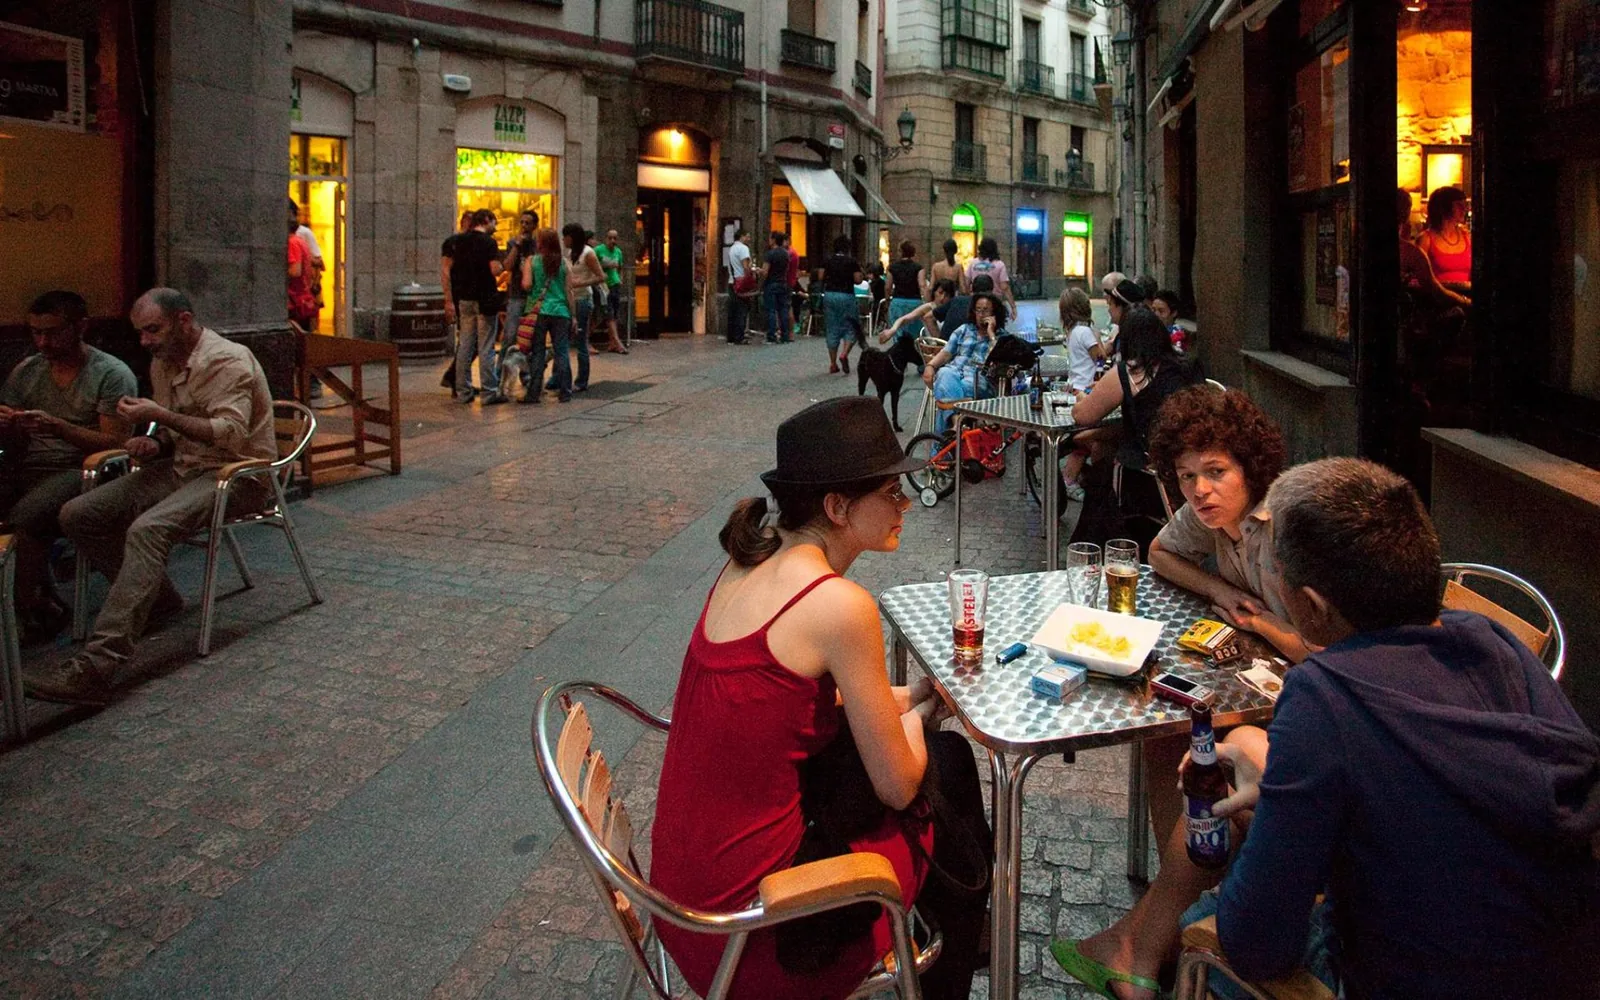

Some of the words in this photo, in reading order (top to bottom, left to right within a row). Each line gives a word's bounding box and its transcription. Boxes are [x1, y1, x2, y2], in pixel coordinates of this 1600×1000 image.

[16, 81, 59, 97] MARTXA
[494, 104, 526, 123] ZAZPI
[1215, 645, 1238, 660] OCB
